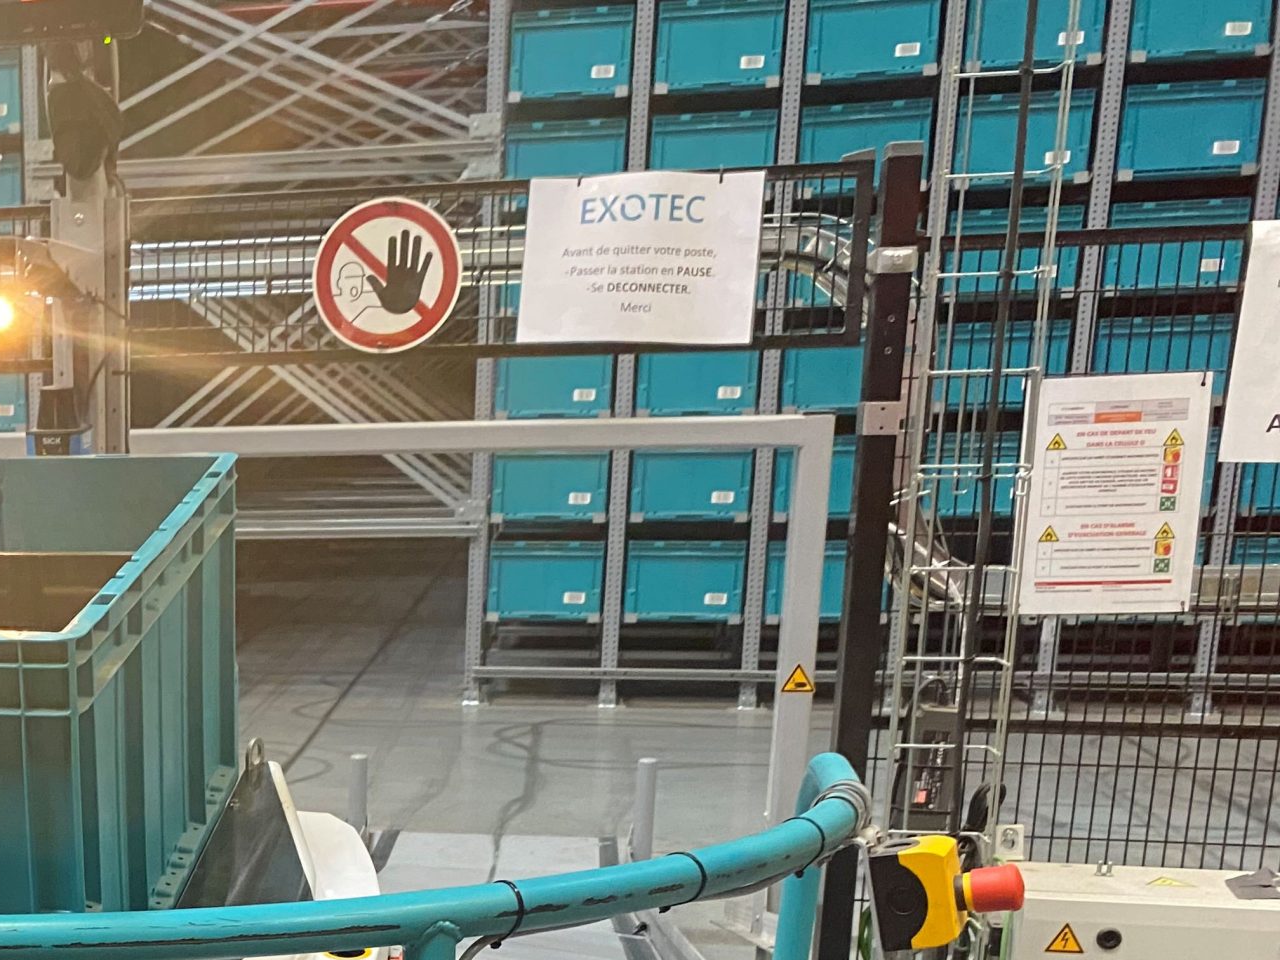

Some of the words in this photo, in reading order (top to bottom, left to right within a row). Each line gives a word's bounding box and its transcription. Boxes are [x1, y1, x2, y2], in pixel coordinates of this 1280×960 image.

[580, 193, 706, 224] EXOTEC
[562, 247, 593, 258] Avant
[596, 245, 610, 257] de
[613, 245, 651, 258] quitter
[654, 246, 681, 257] votre
[684, 247, 717, 259] poste,
[607, 265, 617, 276] la
[620, 265, 658, 276] station
[660, 267, 674, 276] en
[606, 282, 691, 294] DECONNECTER.
[620, 302, 652, 313] Merci
